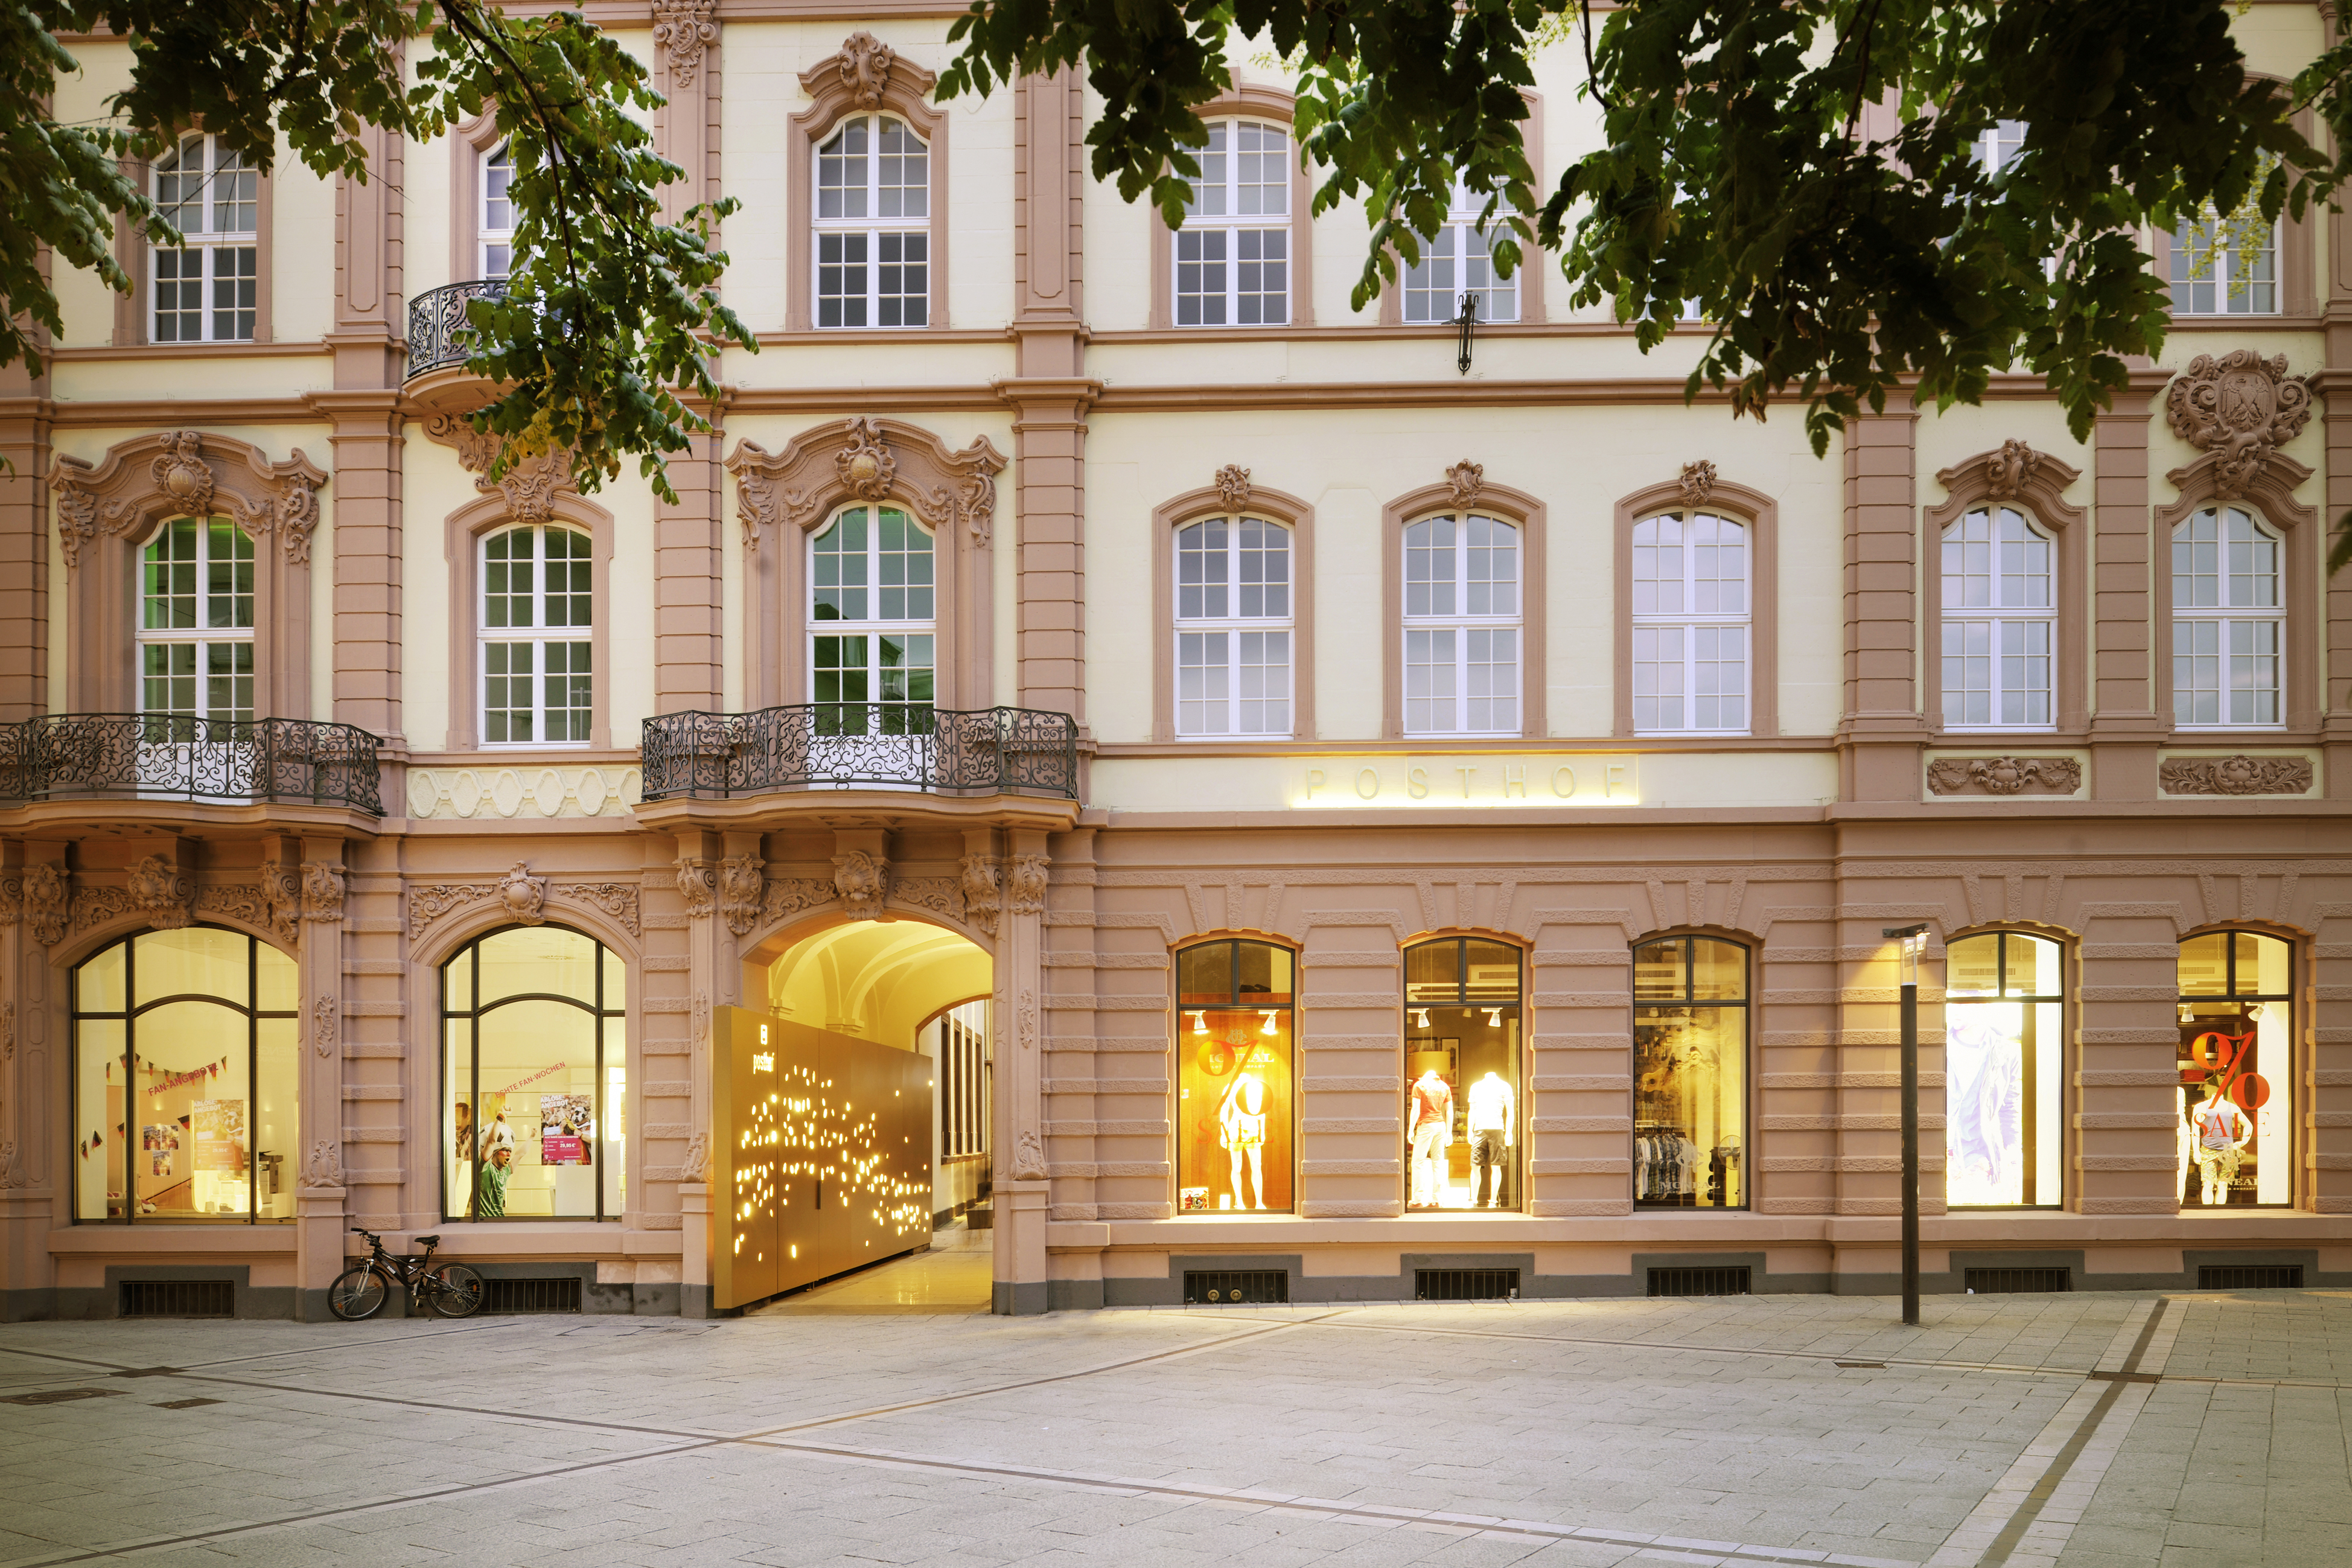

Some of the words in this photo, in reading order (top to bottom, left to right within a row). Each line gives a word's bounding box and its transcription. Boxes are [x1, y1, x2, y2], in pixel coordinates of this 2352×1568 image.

[1306, 763, 1625, 800] POSTHOF
[148, 1062, 218, 1097] FAN-ANGEBOTE
[495, 1083, 518, 1098] ECHTE
[518, 1061, 566, 1087] FAN-WOCHEN
[194, 1104, 221, 1113] ANGEBOT
[541, 1099, 569, 1109] ANGEBOT
[1197, 1118, 1274, 1144] SALE
[2193, 1112, 2271, 1138] SALE
